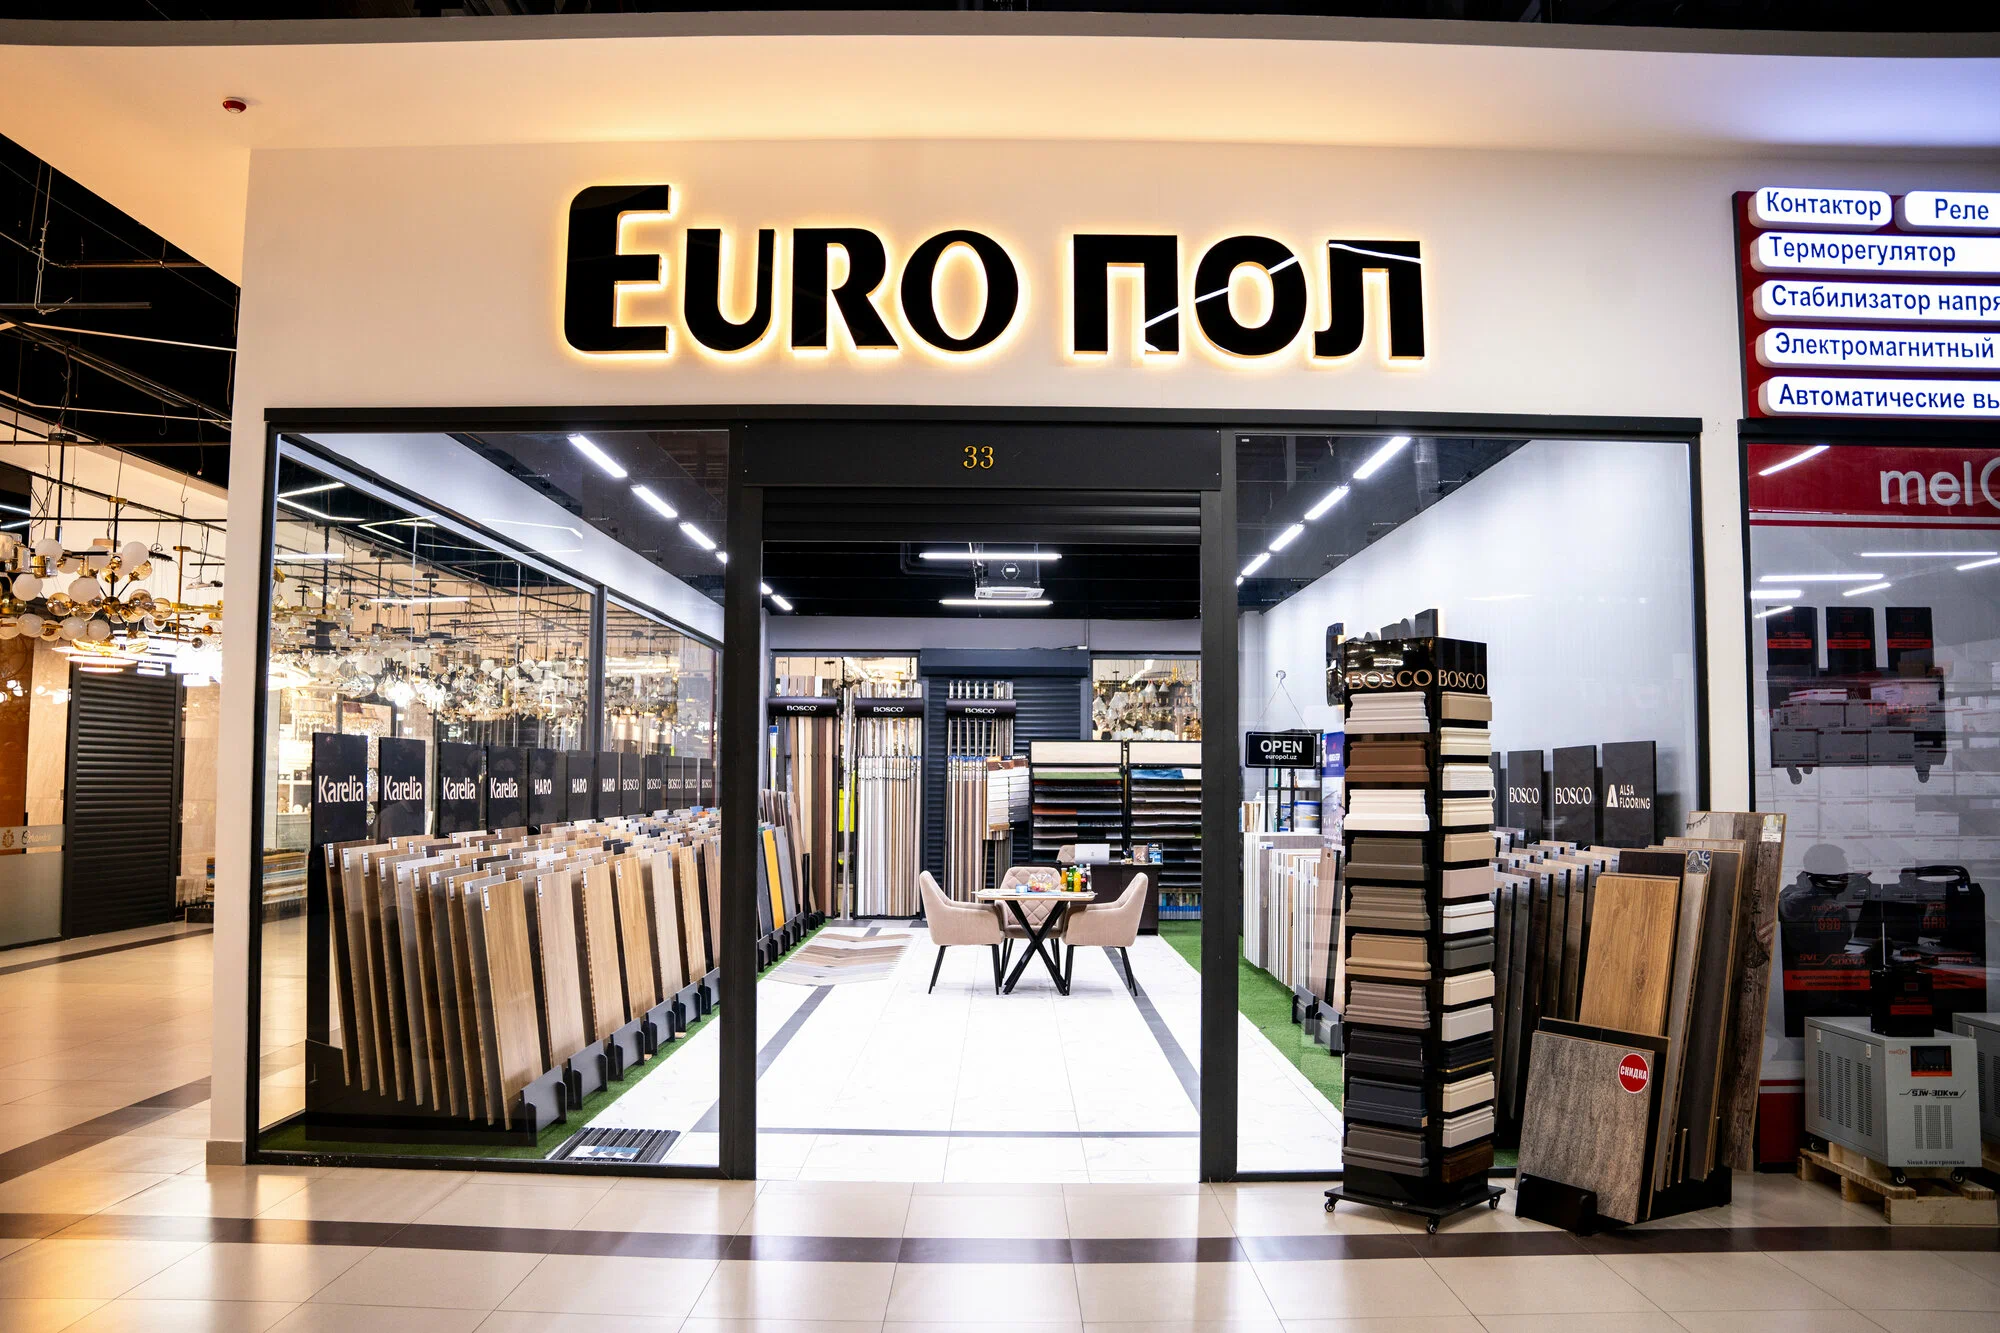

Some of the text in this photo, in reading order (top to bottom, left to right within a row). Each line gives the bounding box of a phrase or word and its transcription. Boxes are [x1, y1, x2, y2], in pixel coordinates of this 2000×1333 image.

[1766, 191, 1882, 221] Контактор
[1934, 198, 1989, 221] Реле
[1769, 236, 1956, 267] Терморегулятор
[1771, 284, 1931, 314] Стабилизатор
[1775, 332, 1994, 360] Электромагнитный
[1779, 383, 1965, 409] Автоматические
[963, 445, 994, 469] 33
[1348, 669, 1433, 690] BOSCO
[1438, 669, 1486, 690] BOSCO
[1260, 739, 1303, 753] OPEN
[318, 775, 364, 803] Karelia
[383, 775, 423, 800] Karelia
[442, 776, 476, 800] Karelia
[490, 777, 519, 799] Karelia
[534, 779, 552, 795] HARO
[571, 778, 588, 794] HARO
[602, 778, 616, 793] HARO
[622, 778, 640, 791] BOSCO
[646, 778, 662, 790] BOSCO
[1619, 784, 1635, 796] ALSA
[1509, 786, 1540, 804] BOSCO
[1555, 786, 1592, 805] BOSCO
[1619, 797, 1651, 809] FLOORING
[1620, 1065, 1647, 1080] СКИДКА
